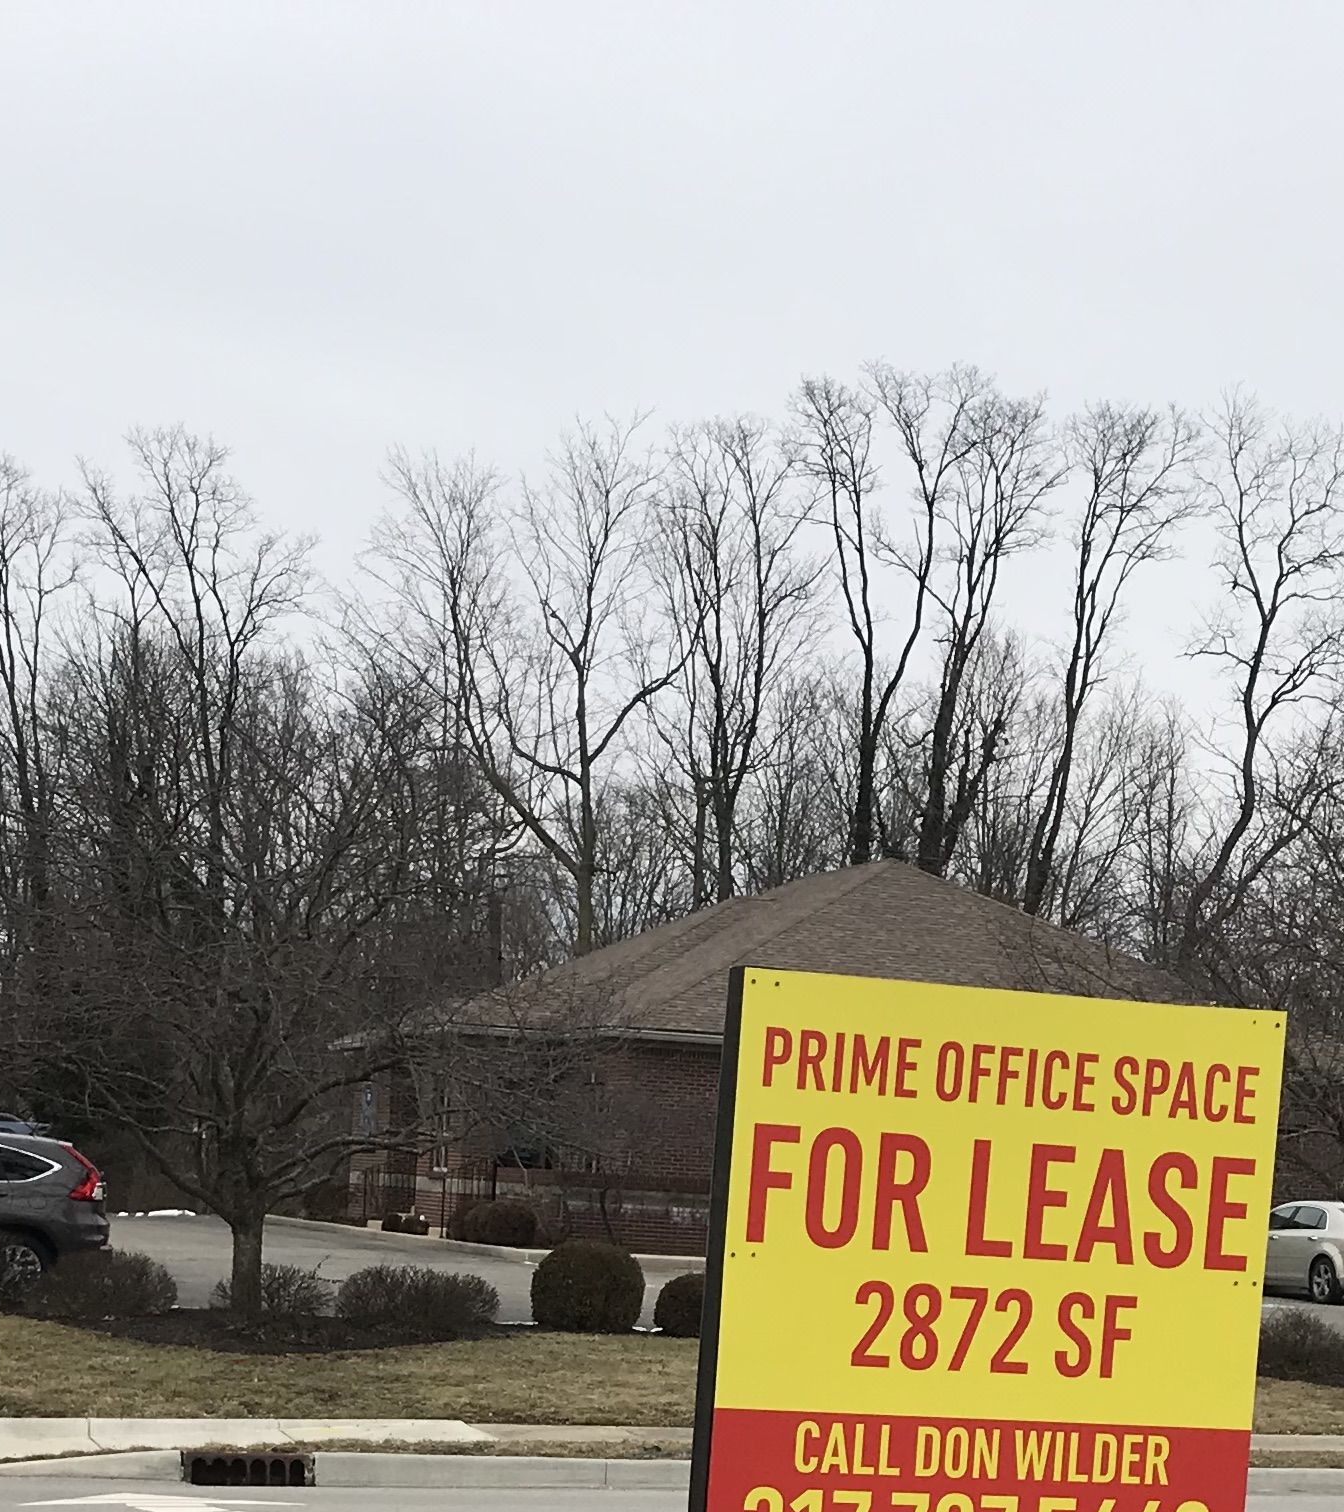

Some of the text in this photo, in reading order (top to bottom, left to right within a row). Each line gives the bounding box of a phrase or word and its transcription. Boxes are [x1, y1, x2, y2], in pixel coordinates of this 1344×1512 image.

[763, 1027, 1259, 1124] PRIME OFFICE SPACE
[746, 1123, 1255, 1271] FOR LEASE
[851, 1281, 1137, 1378] 2872 SF
[795, 1421, 1169, 1485] CALL DON WILDER
